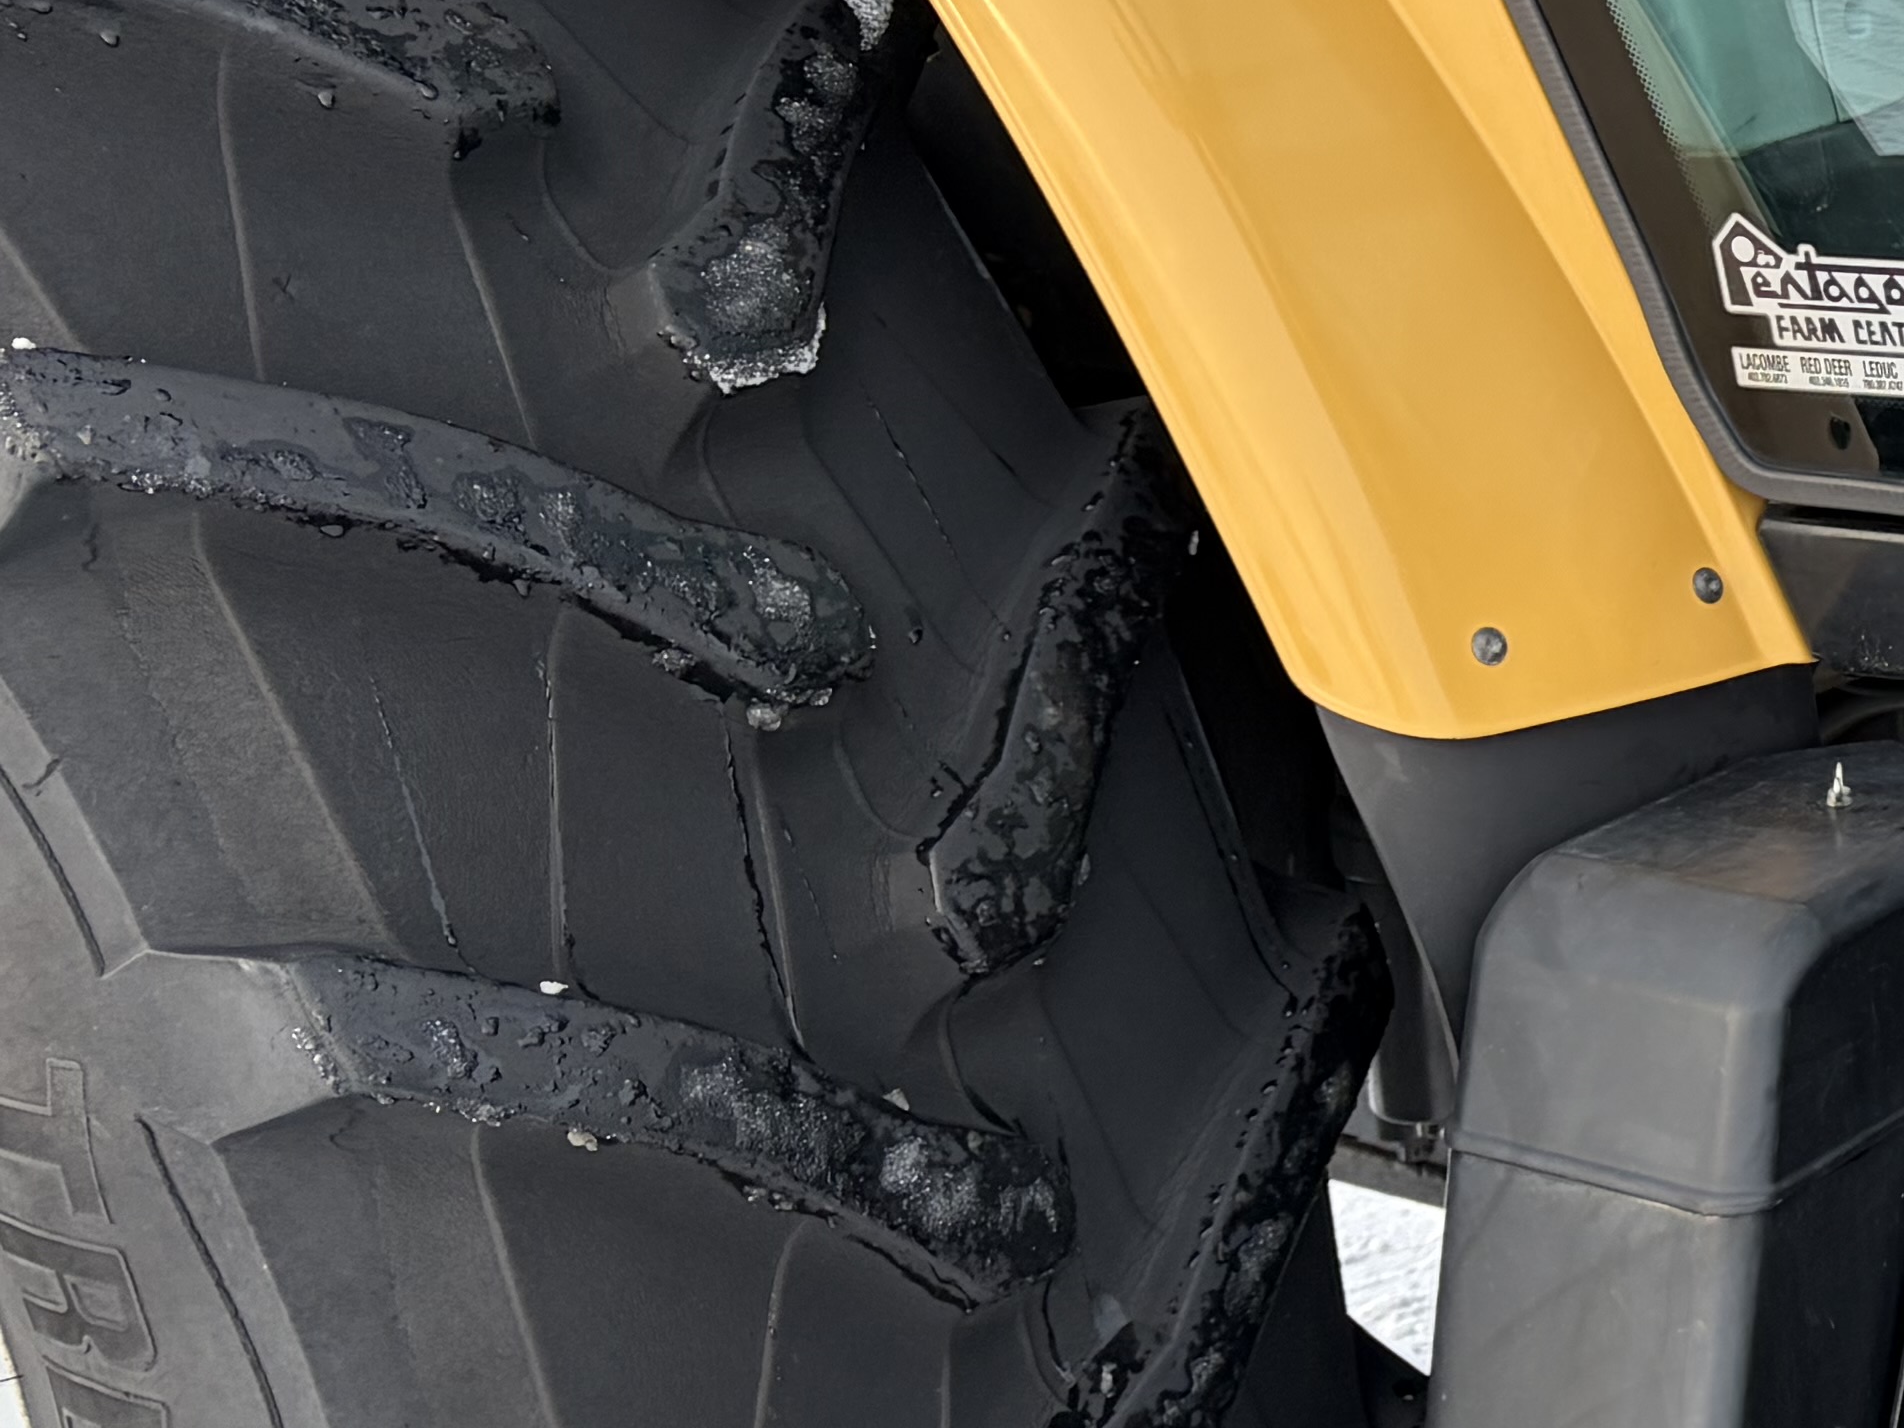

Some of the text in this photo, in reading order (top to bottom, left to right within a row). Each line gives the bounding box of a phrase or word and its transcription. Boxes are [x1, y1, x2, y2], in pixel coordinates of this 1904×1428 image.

[1775, 315, 1846, 344] FARM
[1739, 354, 1791, 373] LACOMBE
[1800, 356, 1822, 376] RED
[1823, 357, 1853, 377] DEER
[1862, 360, 1898, 380] LEDUC
